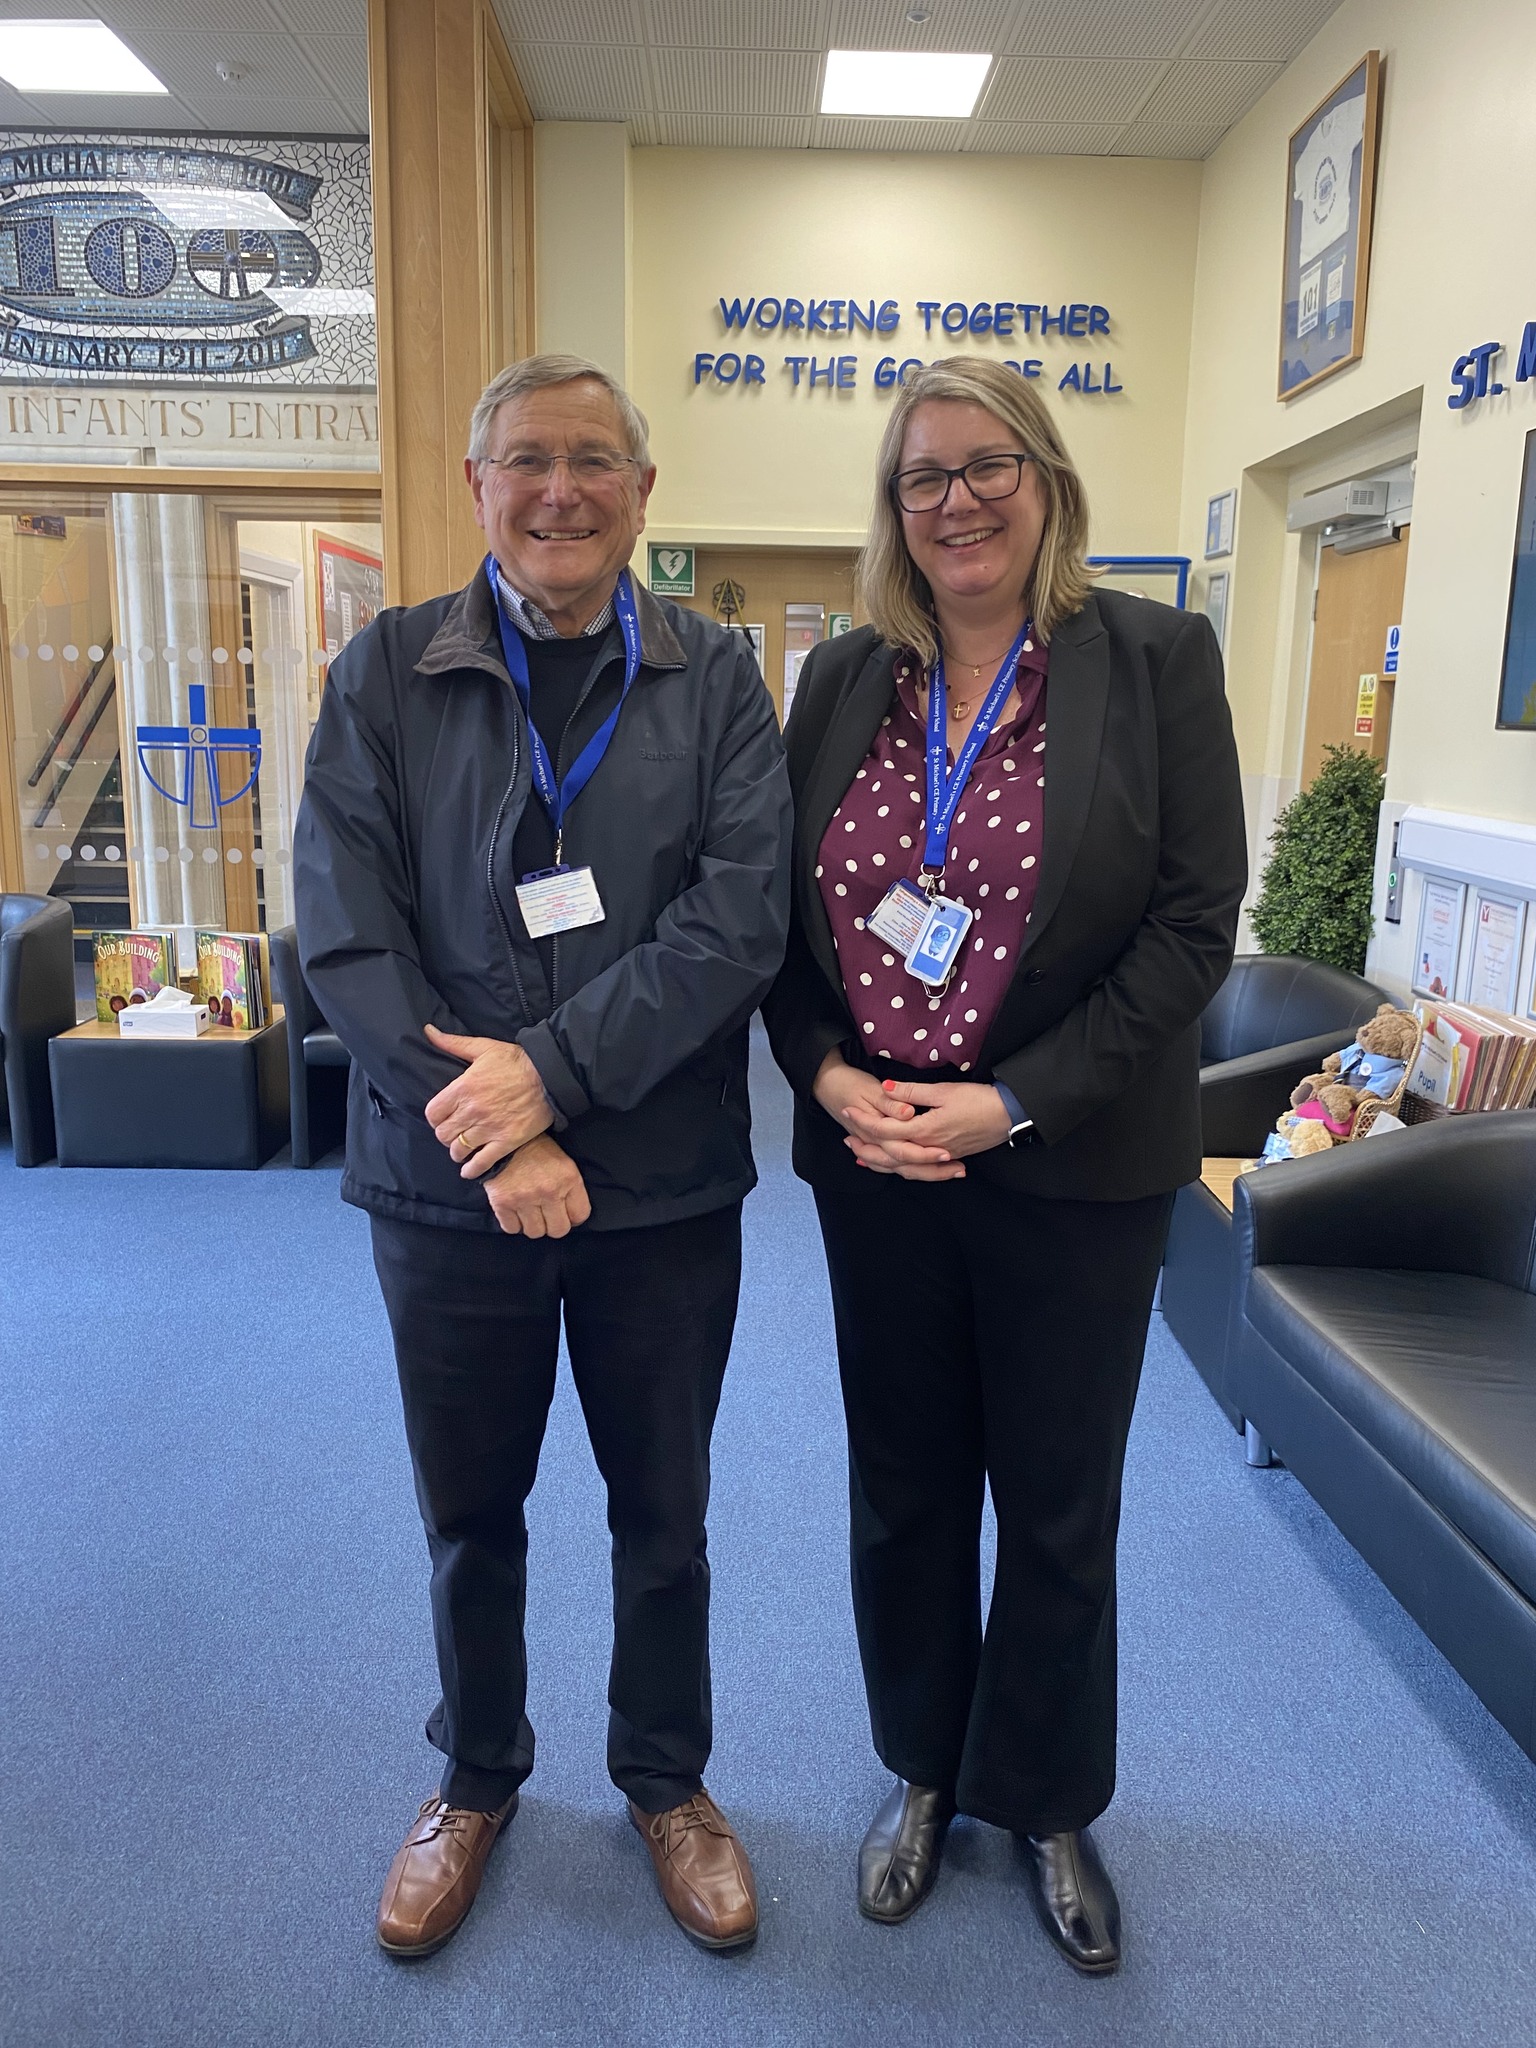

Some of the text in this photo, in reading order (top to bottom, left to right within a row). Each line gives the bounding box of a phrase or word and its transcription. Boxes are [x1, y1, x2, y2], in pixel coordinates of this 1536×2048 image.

[719, 297, 1111, 337] WORKING TOGETHER
[1303, 283, 1318, 317] 101
[0, 329, 137, 367] ENTENARY
[695, 353, 766, 385] FOR
[785, 356, 858, 388] THE
[1059, 362, 1124, 394] ALL
[1447, 341, 1504, 409] ST.
[9, 395, 379, 442] INFANTS' ENTRA
[653, 583, 691, 593] Defibrillator
[986, 692, 1002, 716] Michael's
[997, 682, 1006, 693] CE
[1002, 663, 1016, 685] Primary
[640, 748, 688, 760] Barbour
[933, 788, 940, 797] CE
[943, 790, 957, 815] Michael's
[952, 781, 960, 790] CE
[956, 759, 969, 781] Primary
[964, 742, 977, 759] School
[932, 797, 940, 816] Primary
[1418, 1070, 1437, 1093] Pupil
